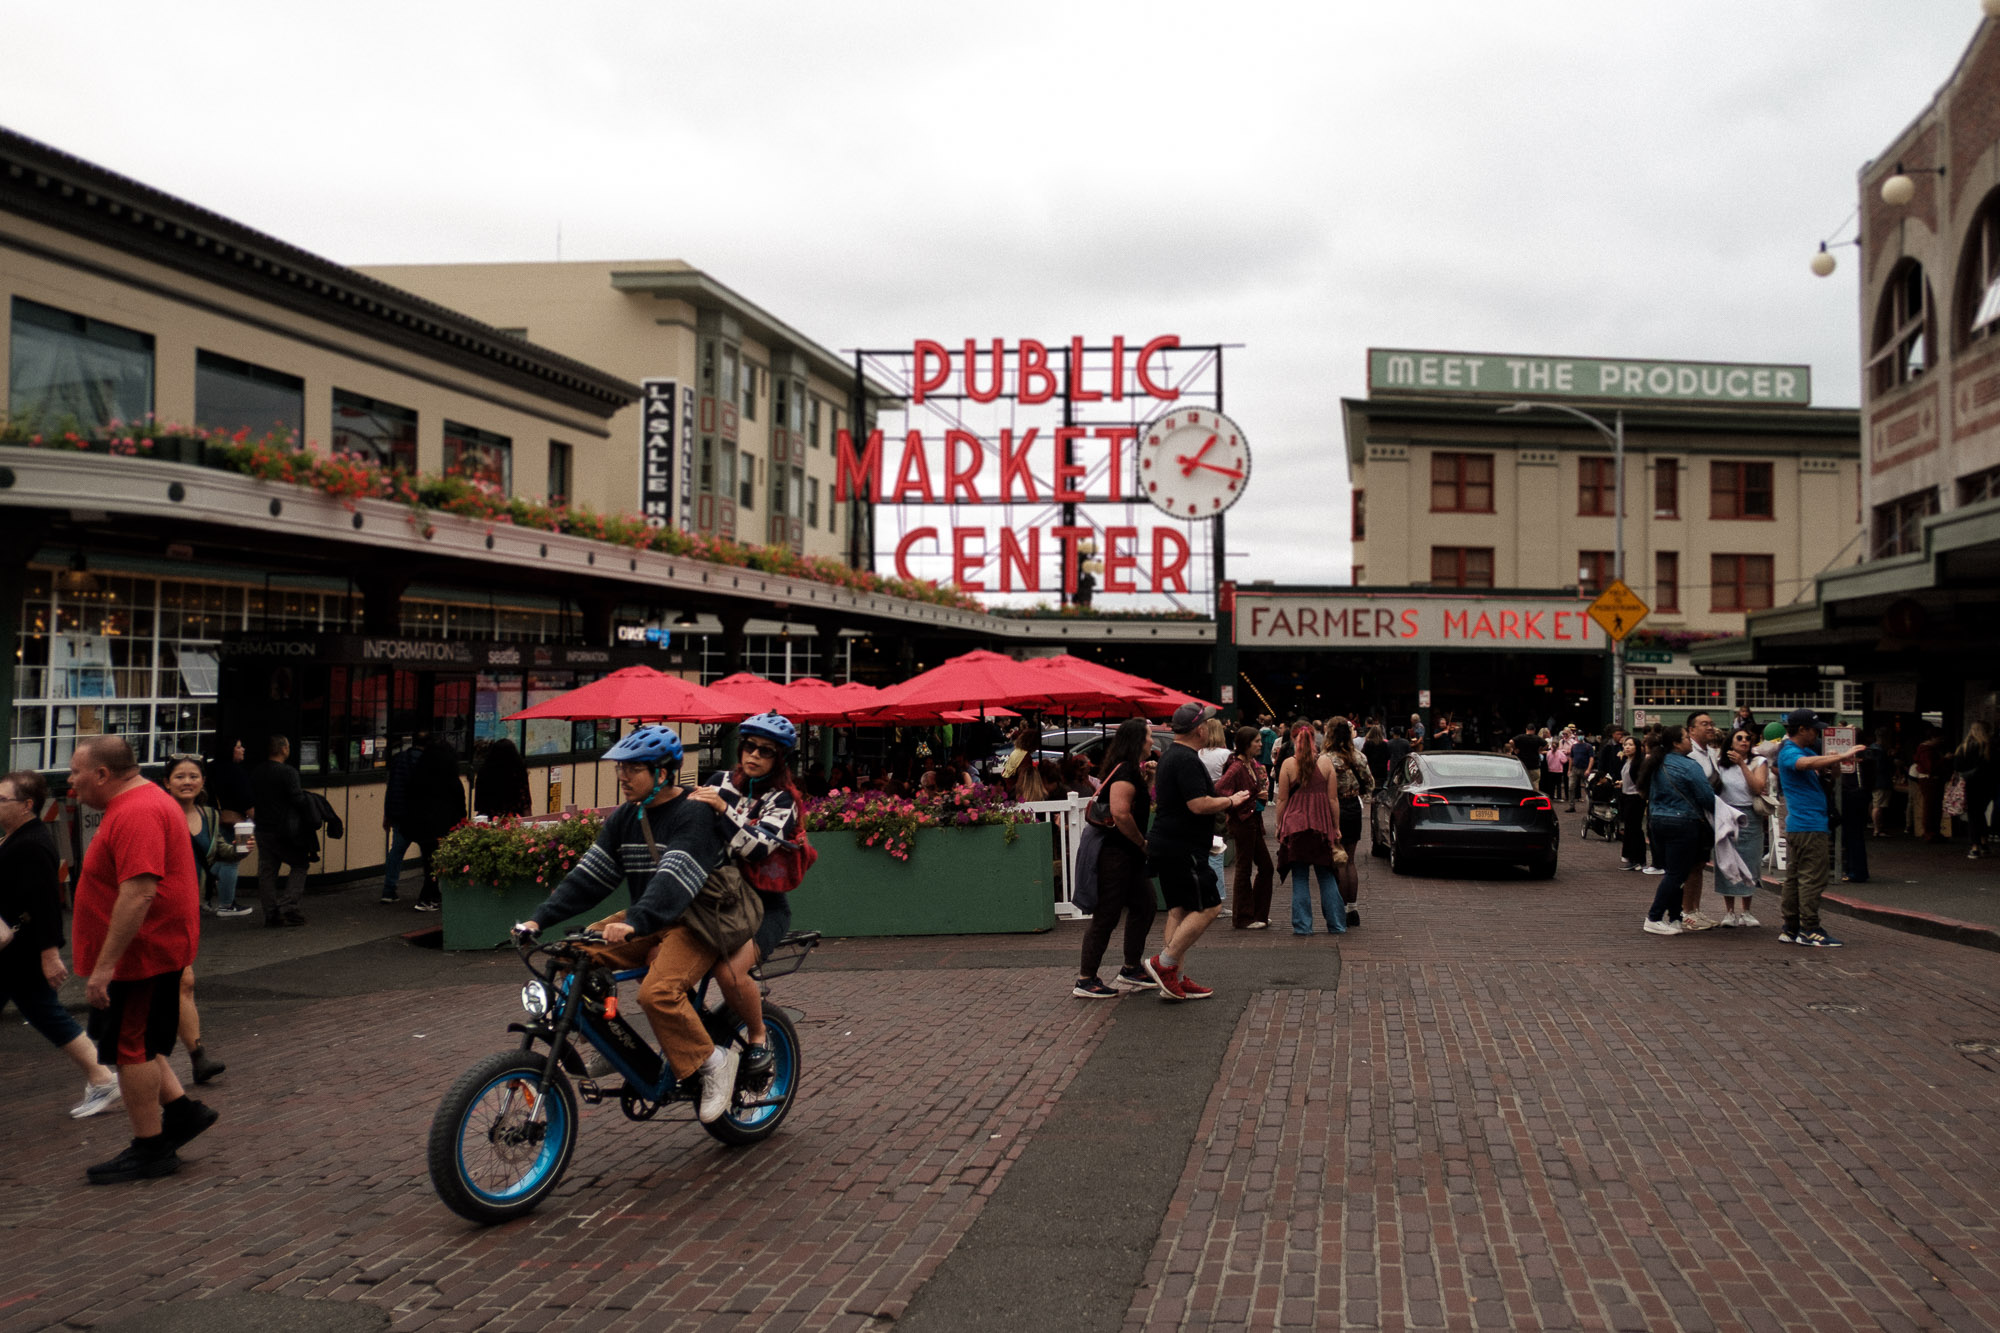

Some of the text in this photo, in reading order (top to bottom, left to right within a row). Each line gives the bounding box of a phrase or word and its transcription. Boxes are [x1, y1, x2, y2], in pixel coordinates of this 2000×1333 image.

[913, 334, 1181, 405] PUBLIC
[1387, 354, 1796, 398] MEET THE PRODUCER
[648, 386, 669, 413] LA
[1165, 417, 1175, 430] 11
[1187, 411, 1200, 424] 12
[1214, 417, 1220, 430] 1
[1148, 434, 1160, 447] 10
[1229, 434, 1237, 447] 2
[647, 418, 670, 492] SALLE
[835, 426, 1139, 503] MARKET
[1227, 480, 1237, 491] 4
[1165, 497, 1174, 509] 7
[1187, 503, 1197, 516] 6
[894, 525, 1191, 594] CENTER
[1251, 607, 1591, 640] FARMERS MARKET
[224, 640, 317, 657] FORMATION
[362, 639, 454, 661] INFORMATION
[566, 650, 610, 663] INFORMATION
[698, 723, 722, 735] ARY
[1827, 738, 1851, 746] STOPS
